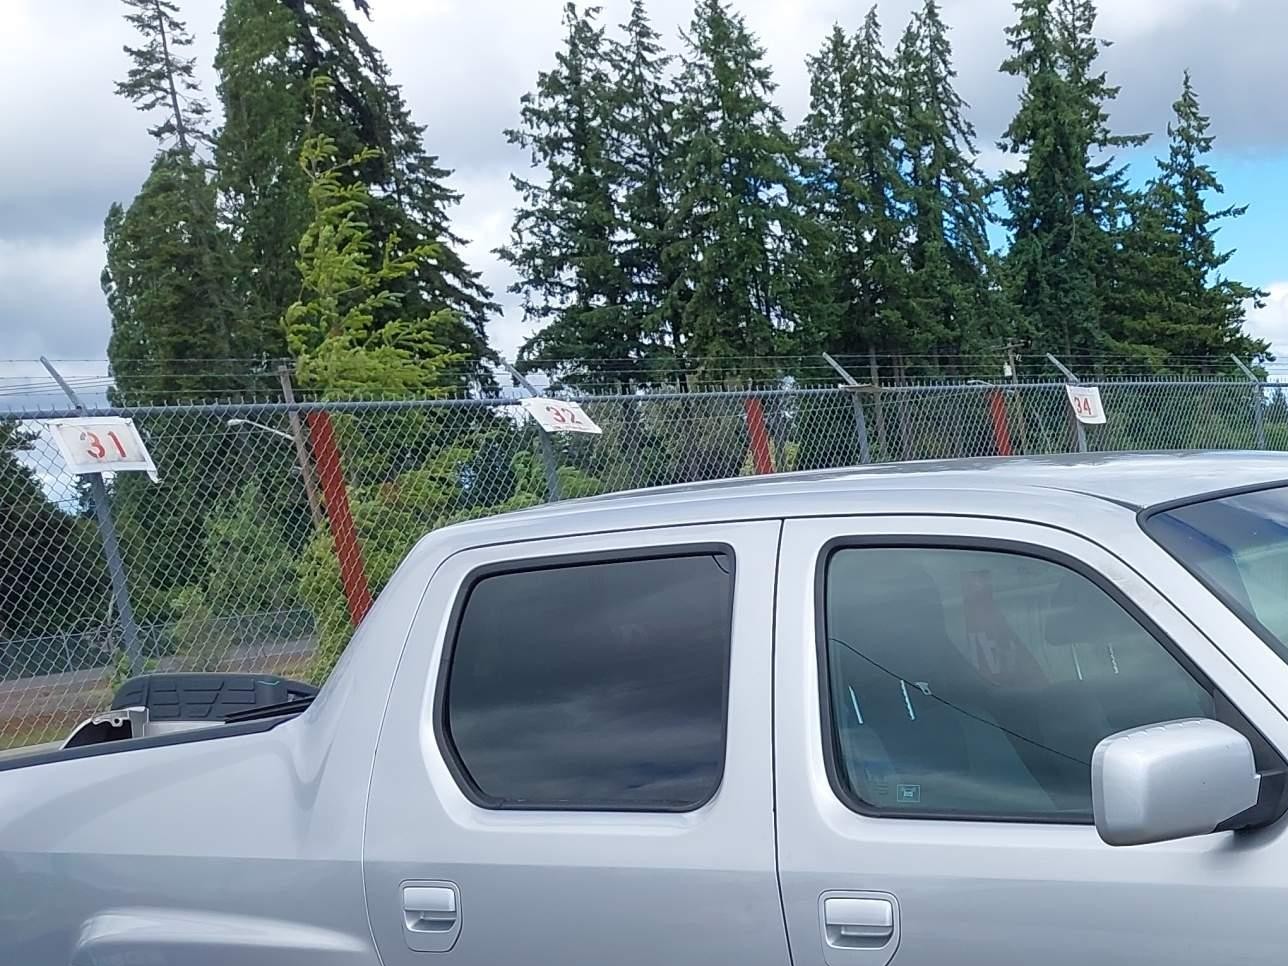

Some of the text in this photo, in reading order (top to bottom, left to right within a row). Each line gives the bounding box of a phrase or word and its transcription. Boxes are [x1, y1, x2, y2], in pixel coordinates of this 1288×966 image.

[1074, 396, 1092, 415] 34
[545, 406, 583, 425] 32
[80, 430, 127, 459] 31
